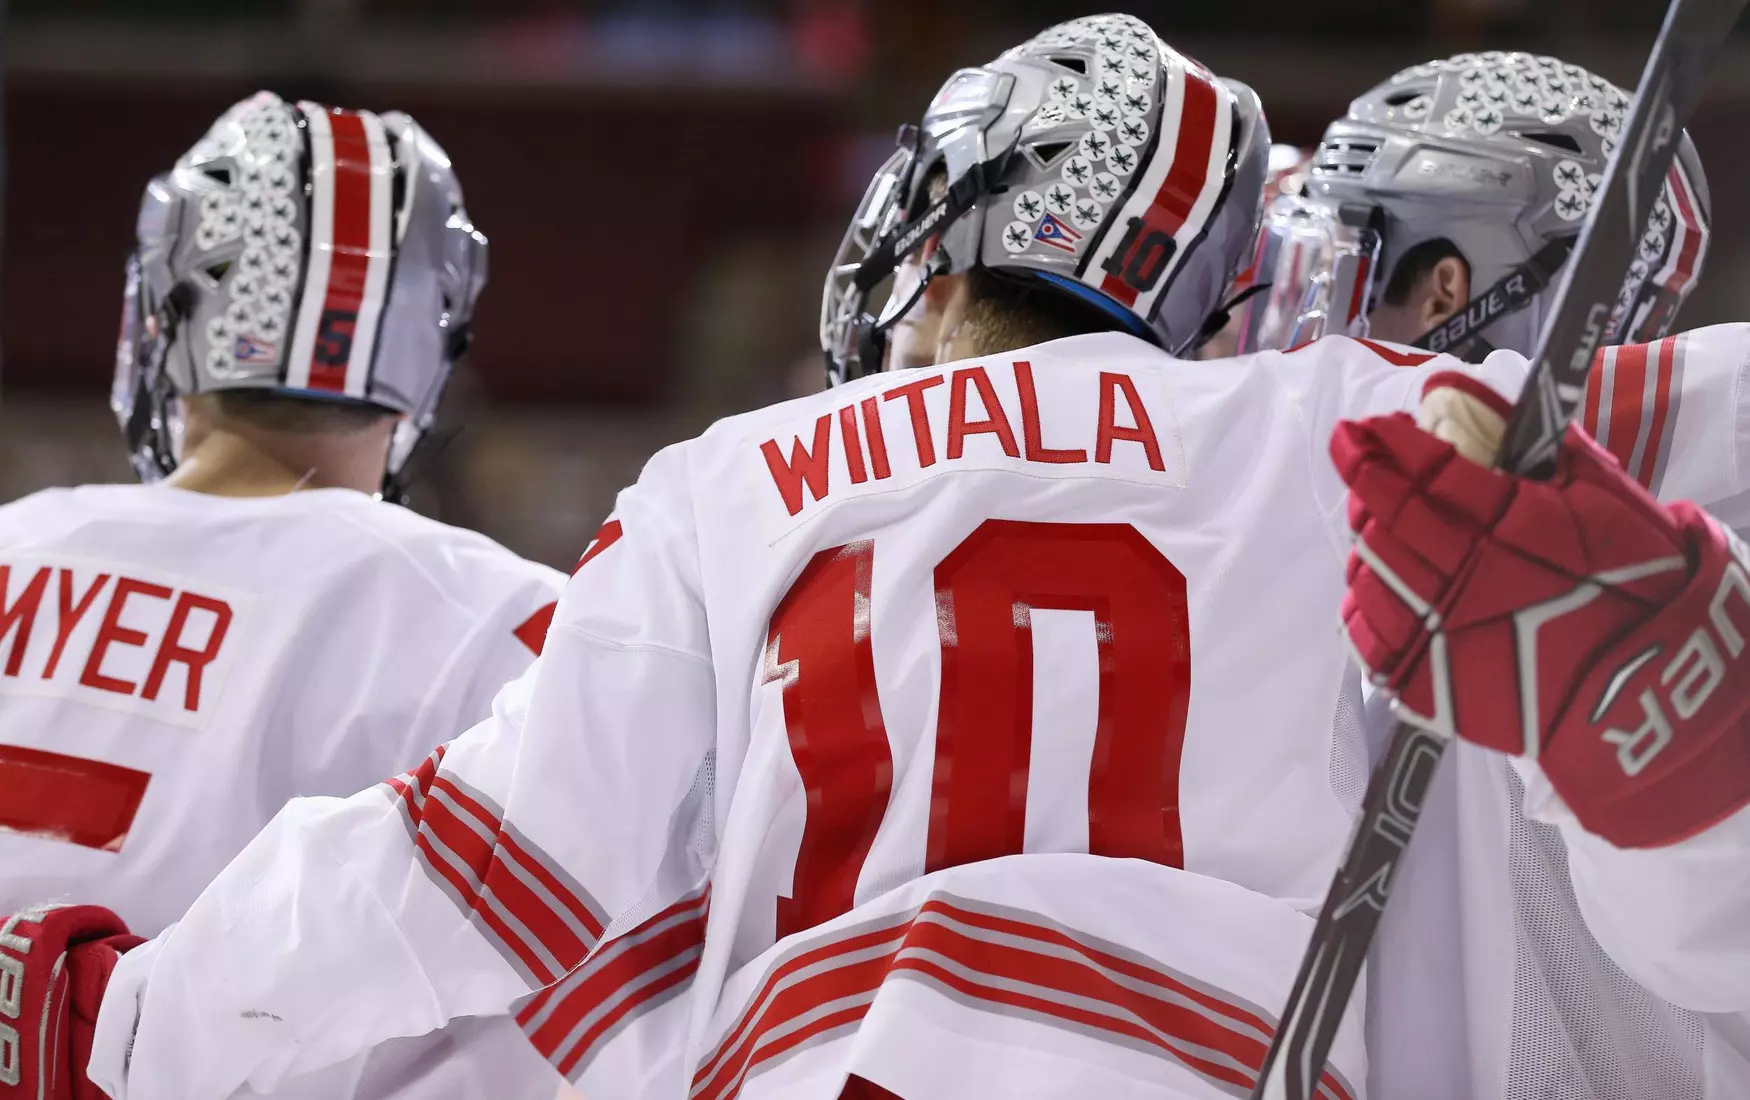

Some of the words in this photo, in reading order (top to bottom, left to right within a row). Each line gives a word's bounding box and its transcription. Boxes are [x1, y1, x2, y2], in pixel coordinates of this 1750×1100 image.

[1101, 215, 1176, 292] 10
[315, 309, 358, 367] 5
[1429, 274, 1526, 352] BAUER
[760, 361, 1166, 517] WIITALA
[0, 565, 233, 711] MYER
[761, 517, 1192, 943] 10
